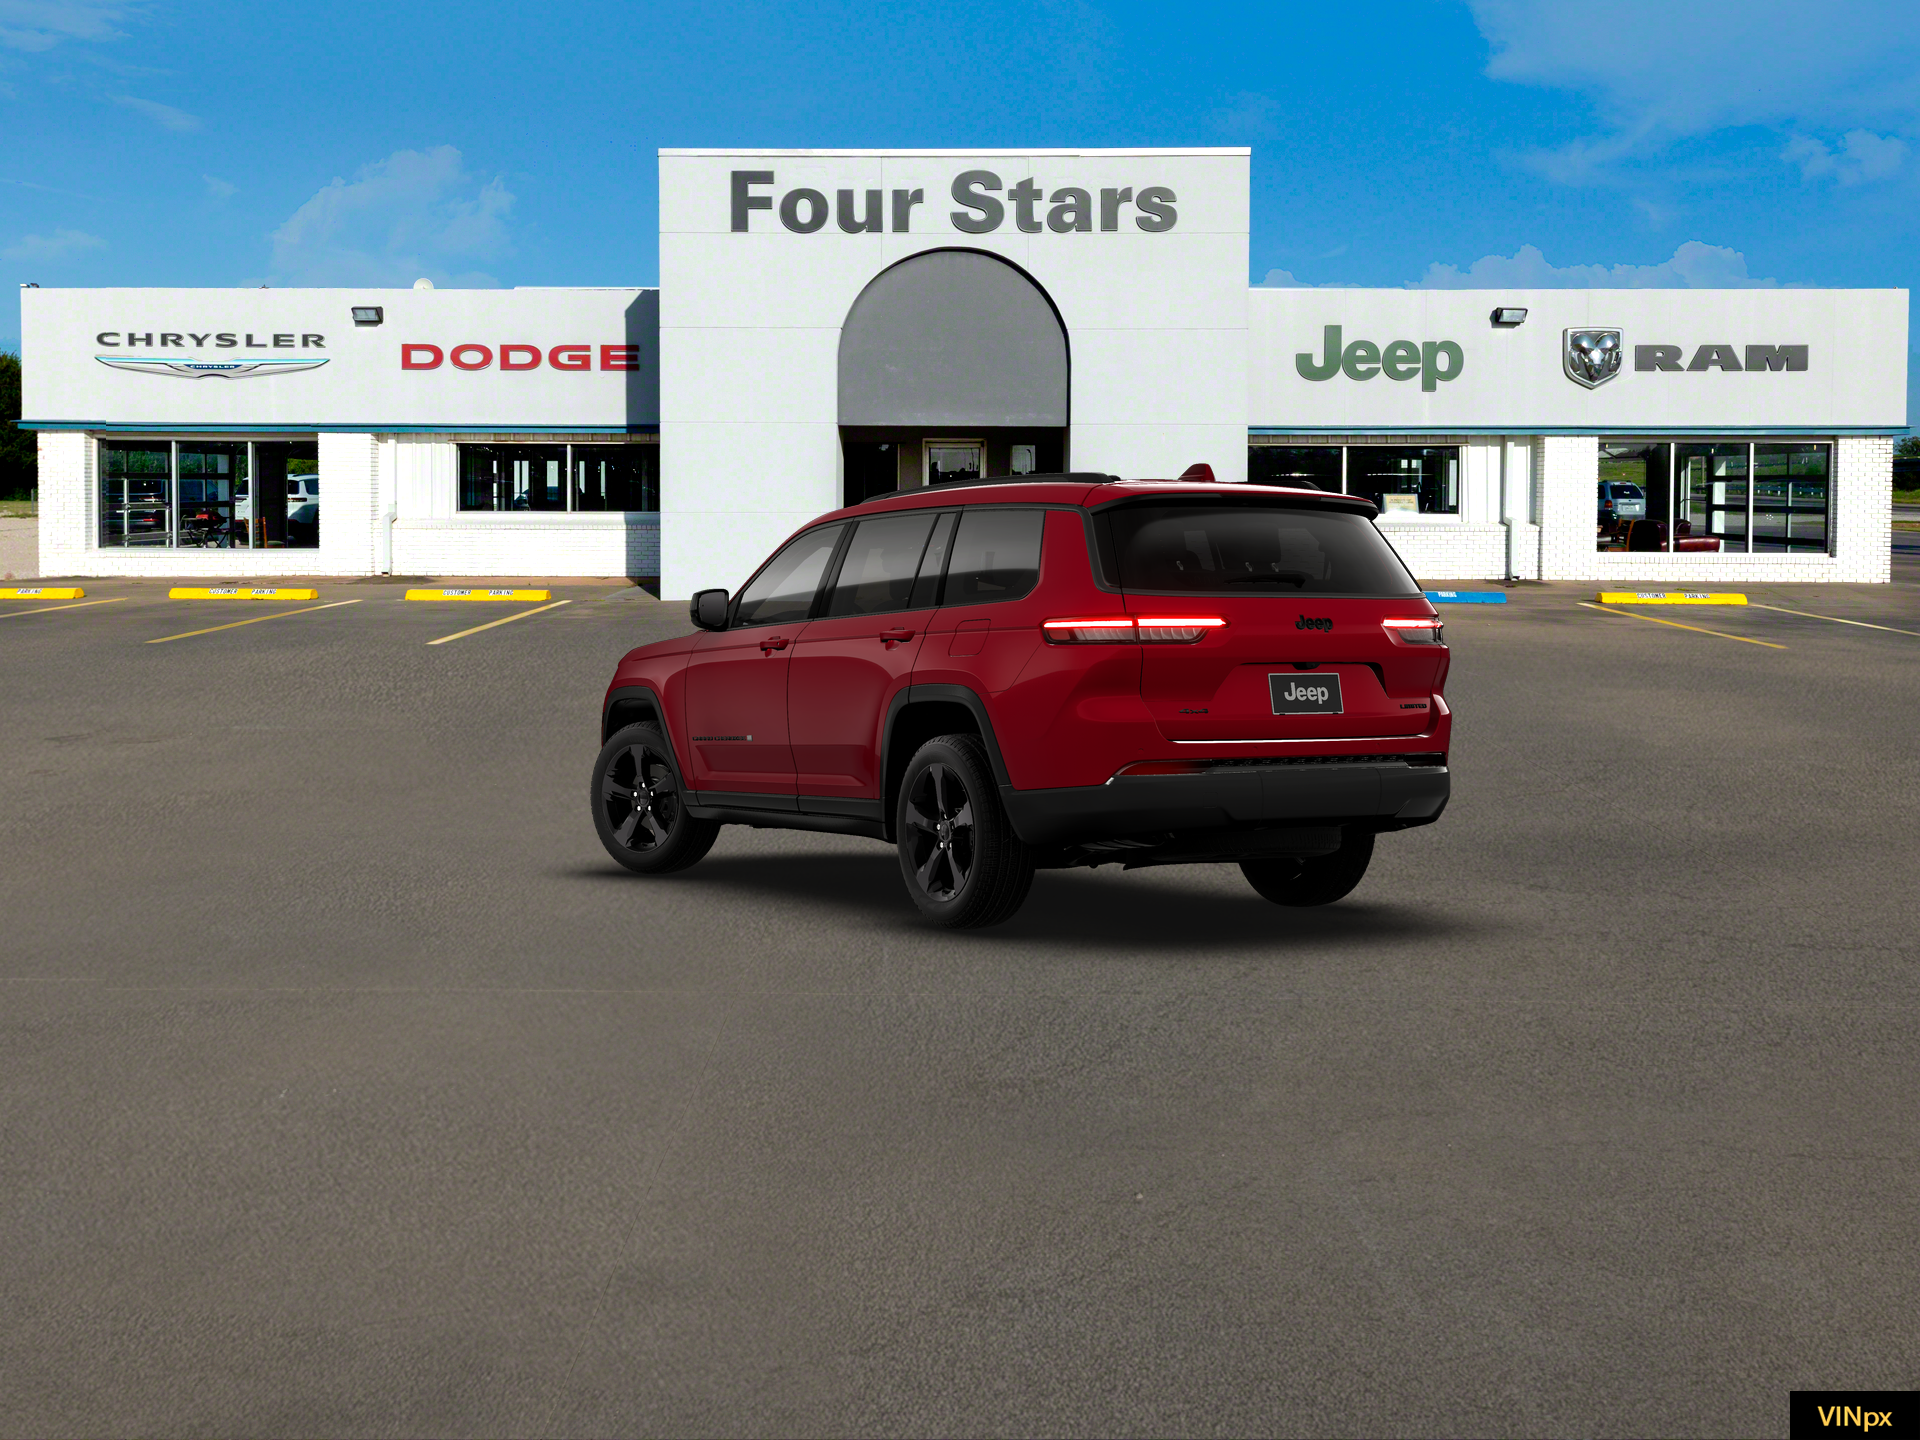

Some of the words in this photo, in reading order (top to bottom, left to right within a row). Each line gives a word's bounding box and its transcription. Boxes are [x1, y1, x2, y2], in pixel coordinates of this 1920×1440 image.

[731, 170, 923, 235] Four
[950, 170, 1178, 235] Stars
[96, 332, 326, 349] CHRYSLER
[401, 343, 640, 371] DODGE
[1295, 325, 1464, 392] Jeep
[1634, 344, 1809, 372] RAM
[1295, 614, 1333, 633] Jeep
[1283, 682, 1329, 705] Jeep
